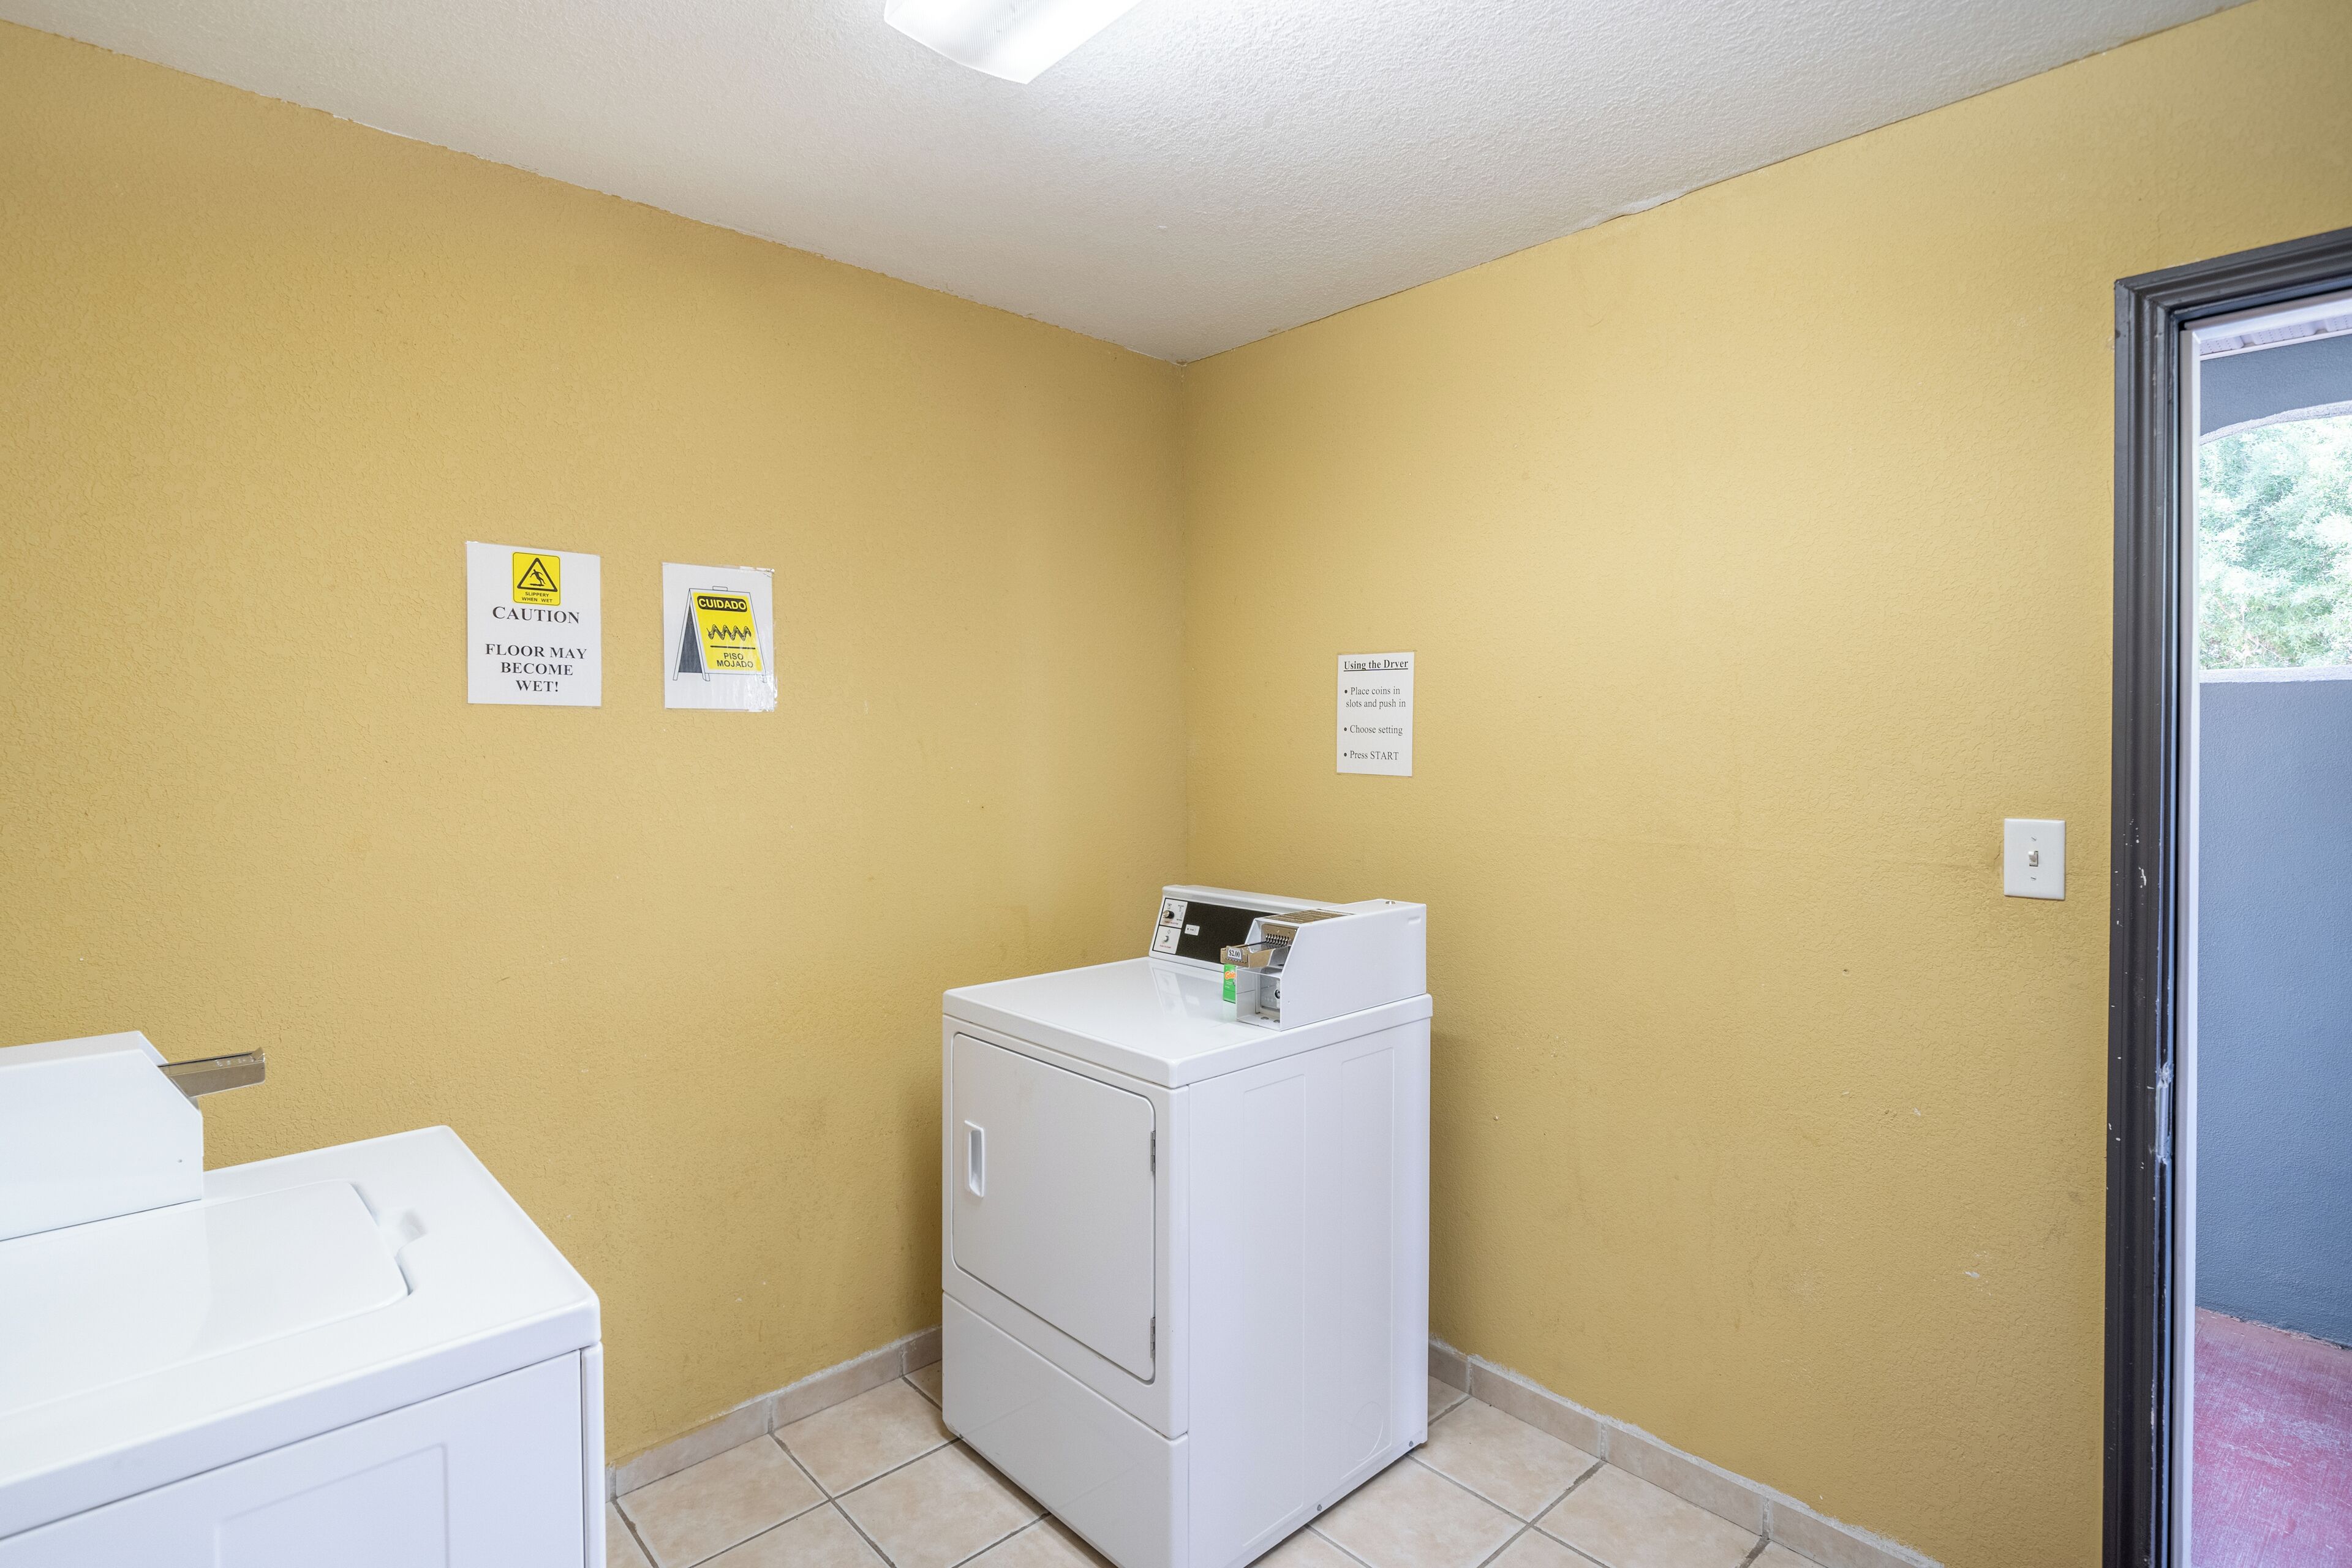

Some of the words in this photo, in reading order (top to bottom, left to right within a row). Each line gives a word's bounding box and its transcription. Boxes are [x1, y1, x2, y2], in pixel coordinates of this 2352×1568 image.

[698, 598, 747, 610] CUIDADO
[492, 606, 579, 624] CAUTION
[485, 643, 545, 657] FLOOR
[549, 647, 587, 659] MAY
[500, 662, 573, 676] BECOME
[1344, 661, 1366, 670] Using
[1368, 660, 1381, 669] the
[1384, 659, 1409, 669] Dryer
[516, 680, 559, 692] WET!
[1371, 686, 1391, 695] coins
[1393, 686, 1401, 695] in
[1379, 699, 1396, 709] push
[1399, 698, 1406, 707] in
[1349, 725, 1376, 733] Choose
[1378, 725, 1403, 736] setting
[1350, 750, 1368, 759] Press
[1370, 750, 1399, 760] START
